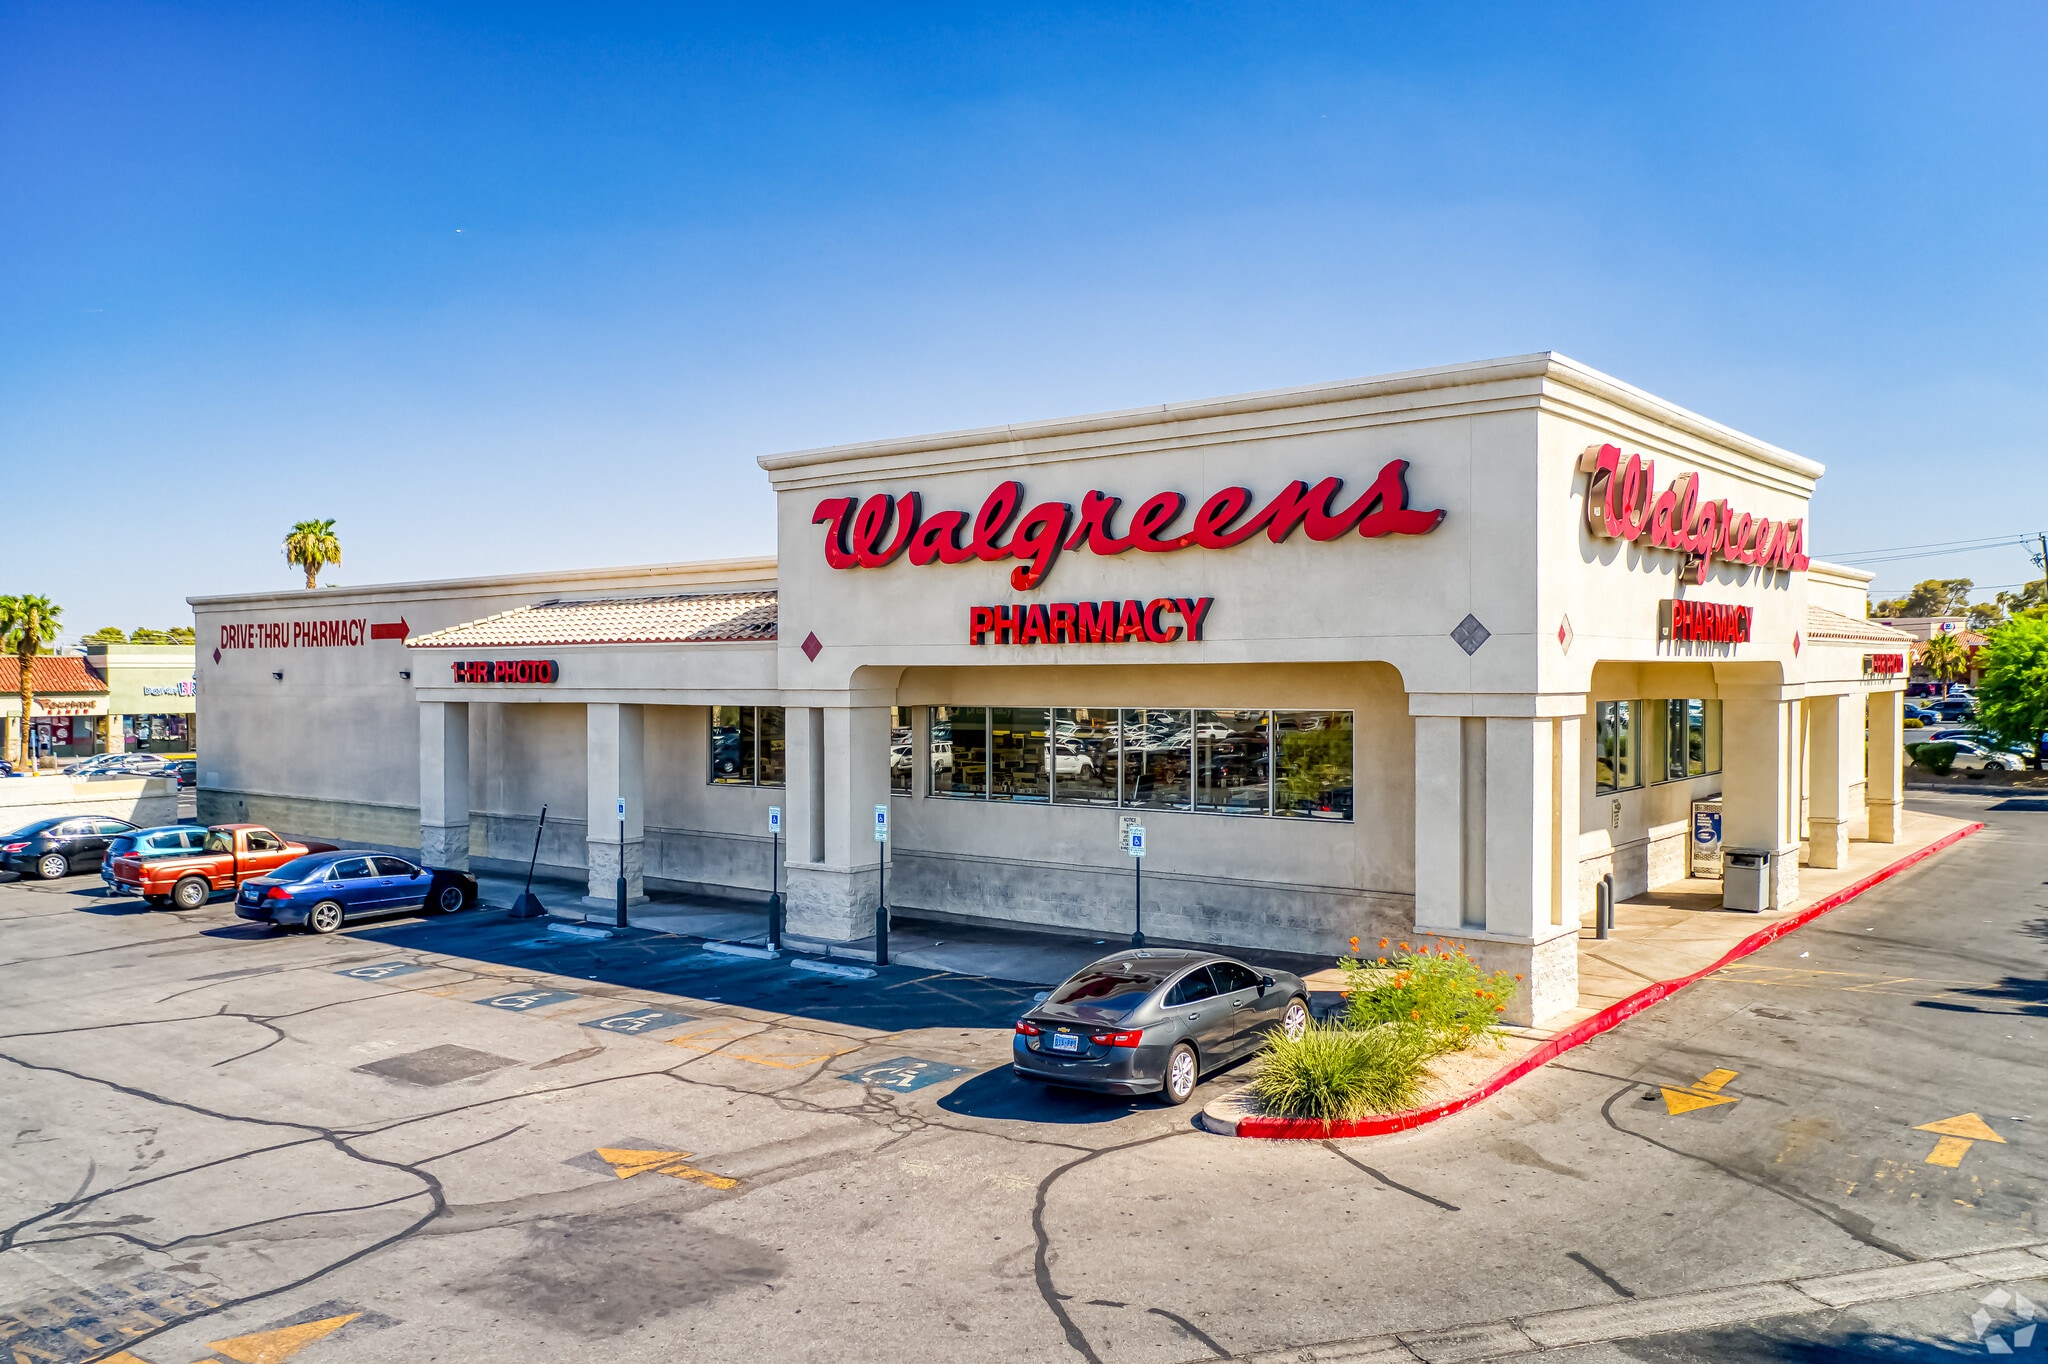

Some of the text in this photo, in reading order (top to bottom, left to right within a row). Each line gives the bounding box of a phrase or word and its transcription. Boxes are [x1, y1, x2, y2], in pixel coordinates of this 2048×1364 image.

[811, 458, 1447, 591] Walgreens
[1594, 443, 1811, 586] Walgreens
[220, 618, 366, 649] DRIVE-THRU PHARMACY
[969, 597, 1214, 645] PHARMACY
[1672, 599, 1753, 643] PHARMACY
[451, 660, 554, 683] 1-HR PHOTO
